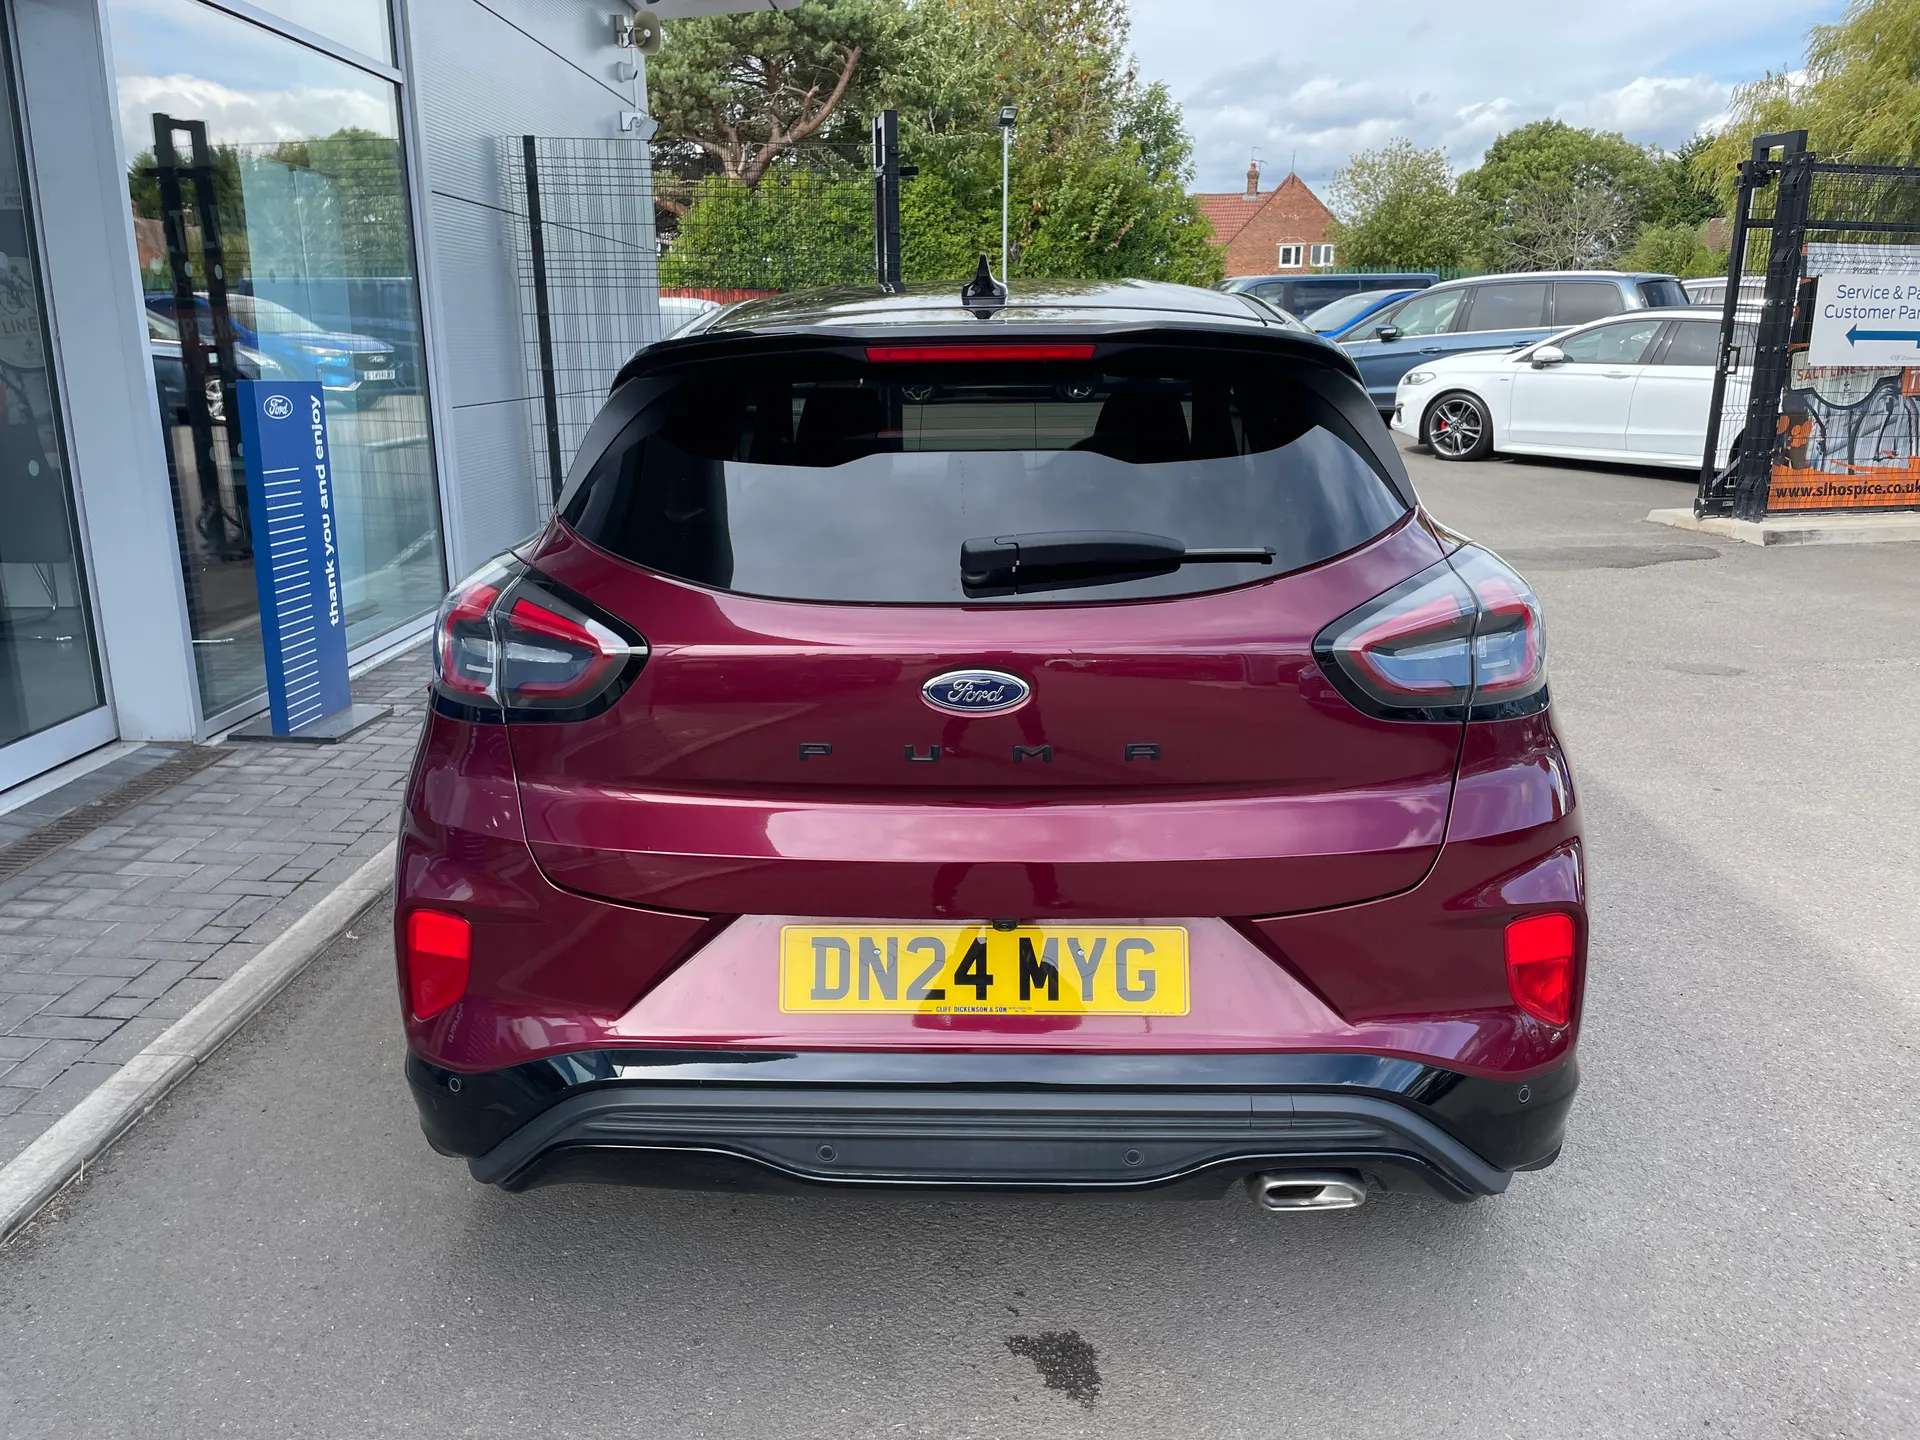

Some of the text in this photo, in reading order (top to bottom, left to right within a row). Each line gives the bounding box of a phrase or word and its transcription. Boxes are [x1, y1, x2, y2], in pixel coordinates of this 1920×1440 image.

[1837, 284, 1889, 299] Service
[1893, 285, 1903, 300] &
[1824, 304, 1895, 319] Customer
[310, 394, 339, 627] thank you and enjoy
[947, 679, 1004, 703] Ford
[799, 742, 1162, 762] PUMA
[810, 936, 1157, 1002] DN24 MYG
